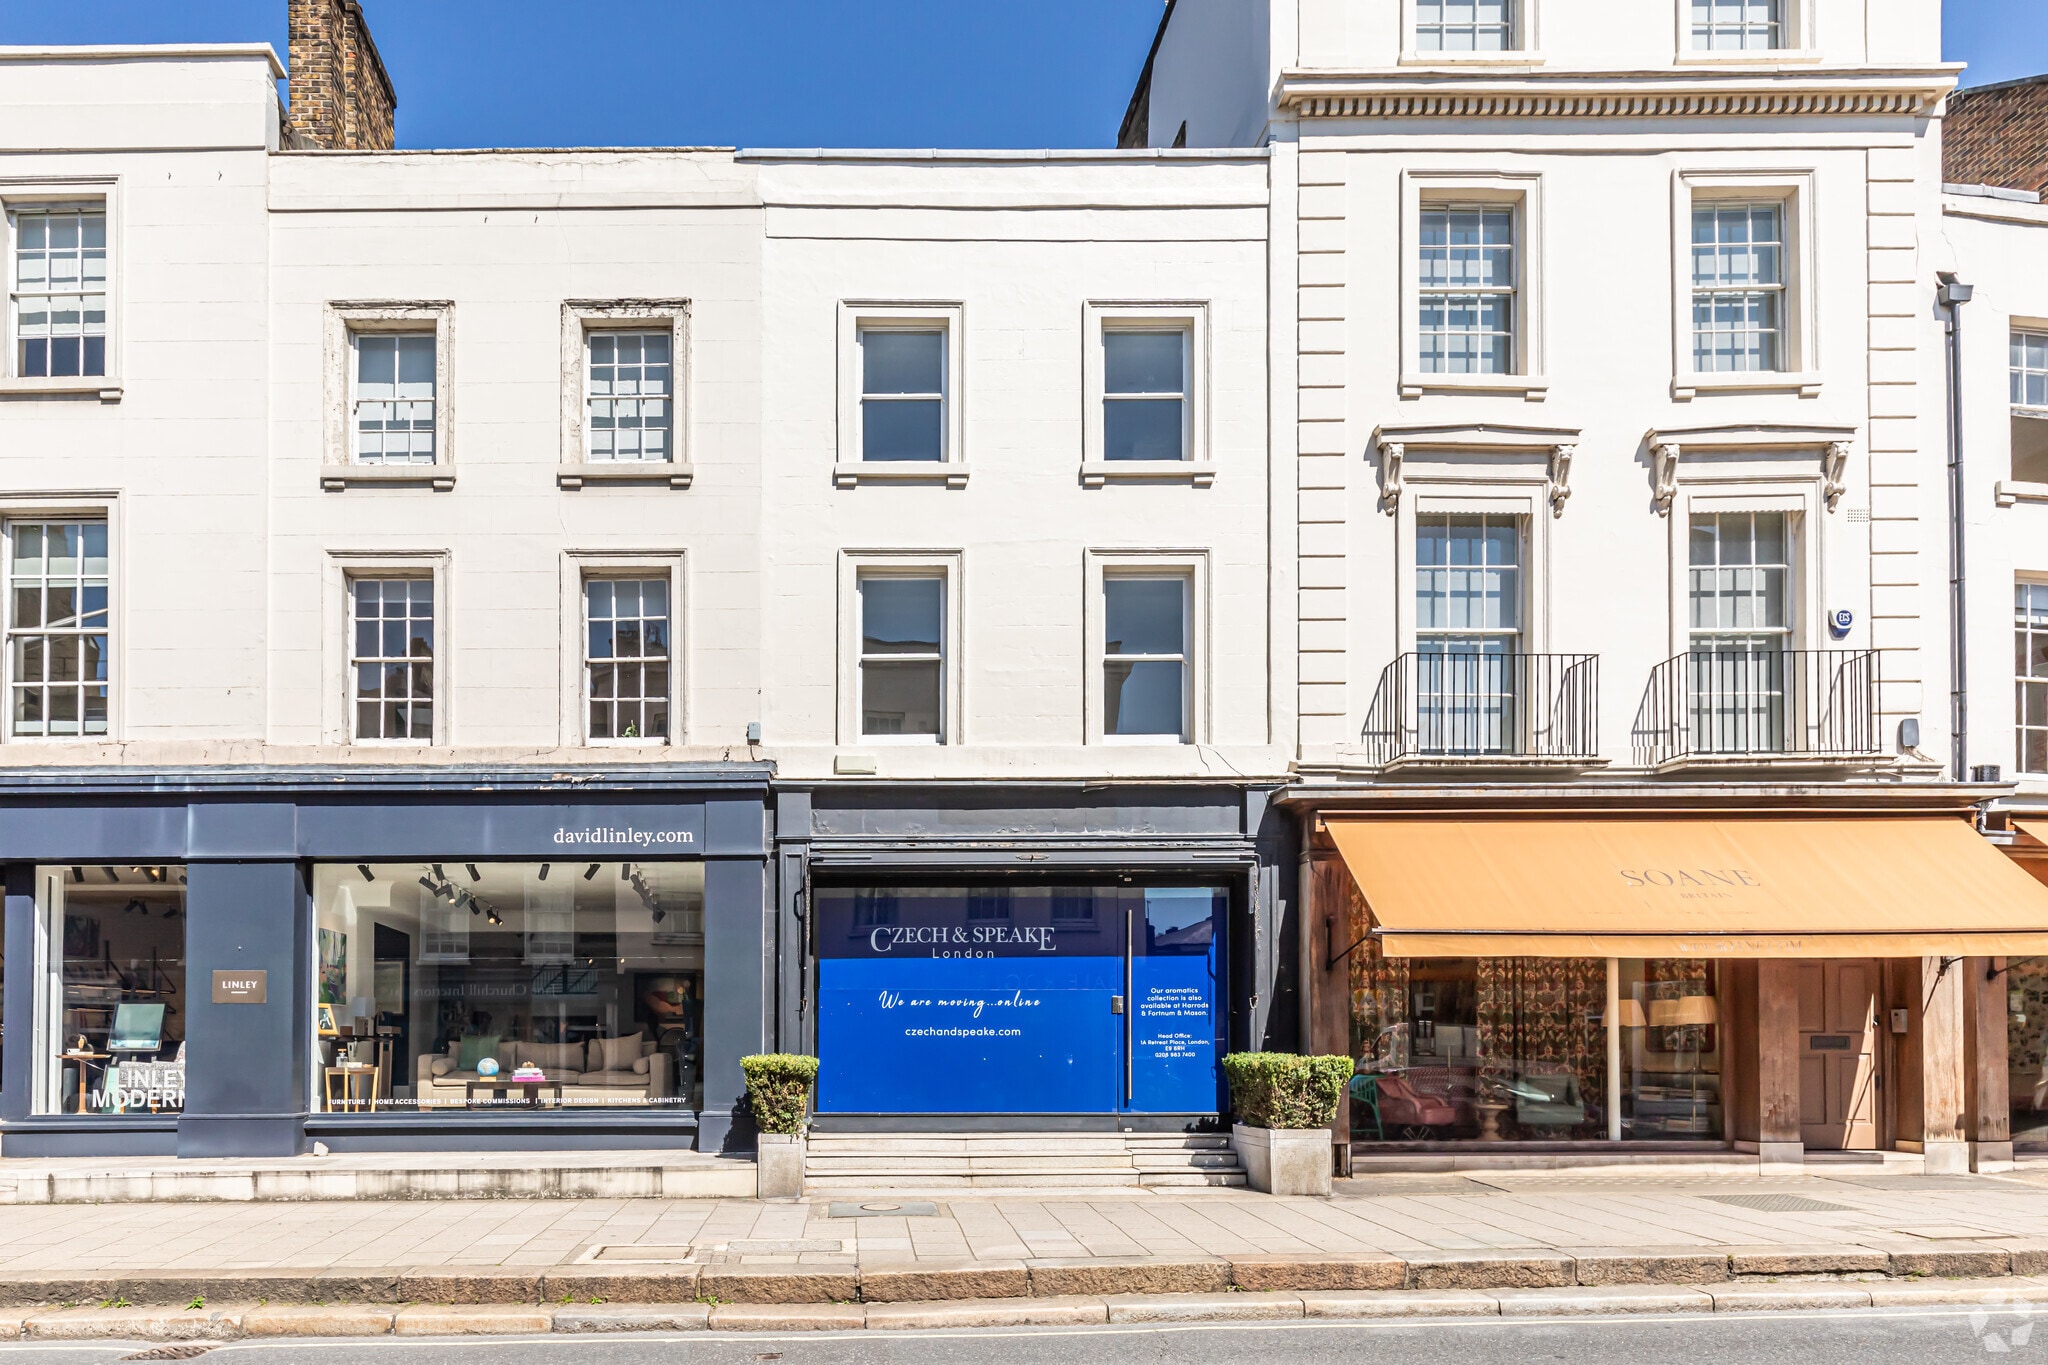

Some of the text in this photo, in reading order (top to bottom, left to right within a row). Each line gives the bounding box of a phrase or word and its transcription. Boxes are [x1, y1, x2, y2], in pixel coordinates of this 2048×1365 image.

[553, 828, 694, 847] davidlinley.com
[1620, 869, 1761, 887] SOANE
[870, 926, 1057, 952] CZECH & SPEAKE
[932, 947, 994, 959] London
[222, 981, 258, 989] LINLEY
[878, 990, 905, 1009] We
[910, 998, 932, 1007] are
[905, 1027, 1021, 1038] czechandspeake.com
